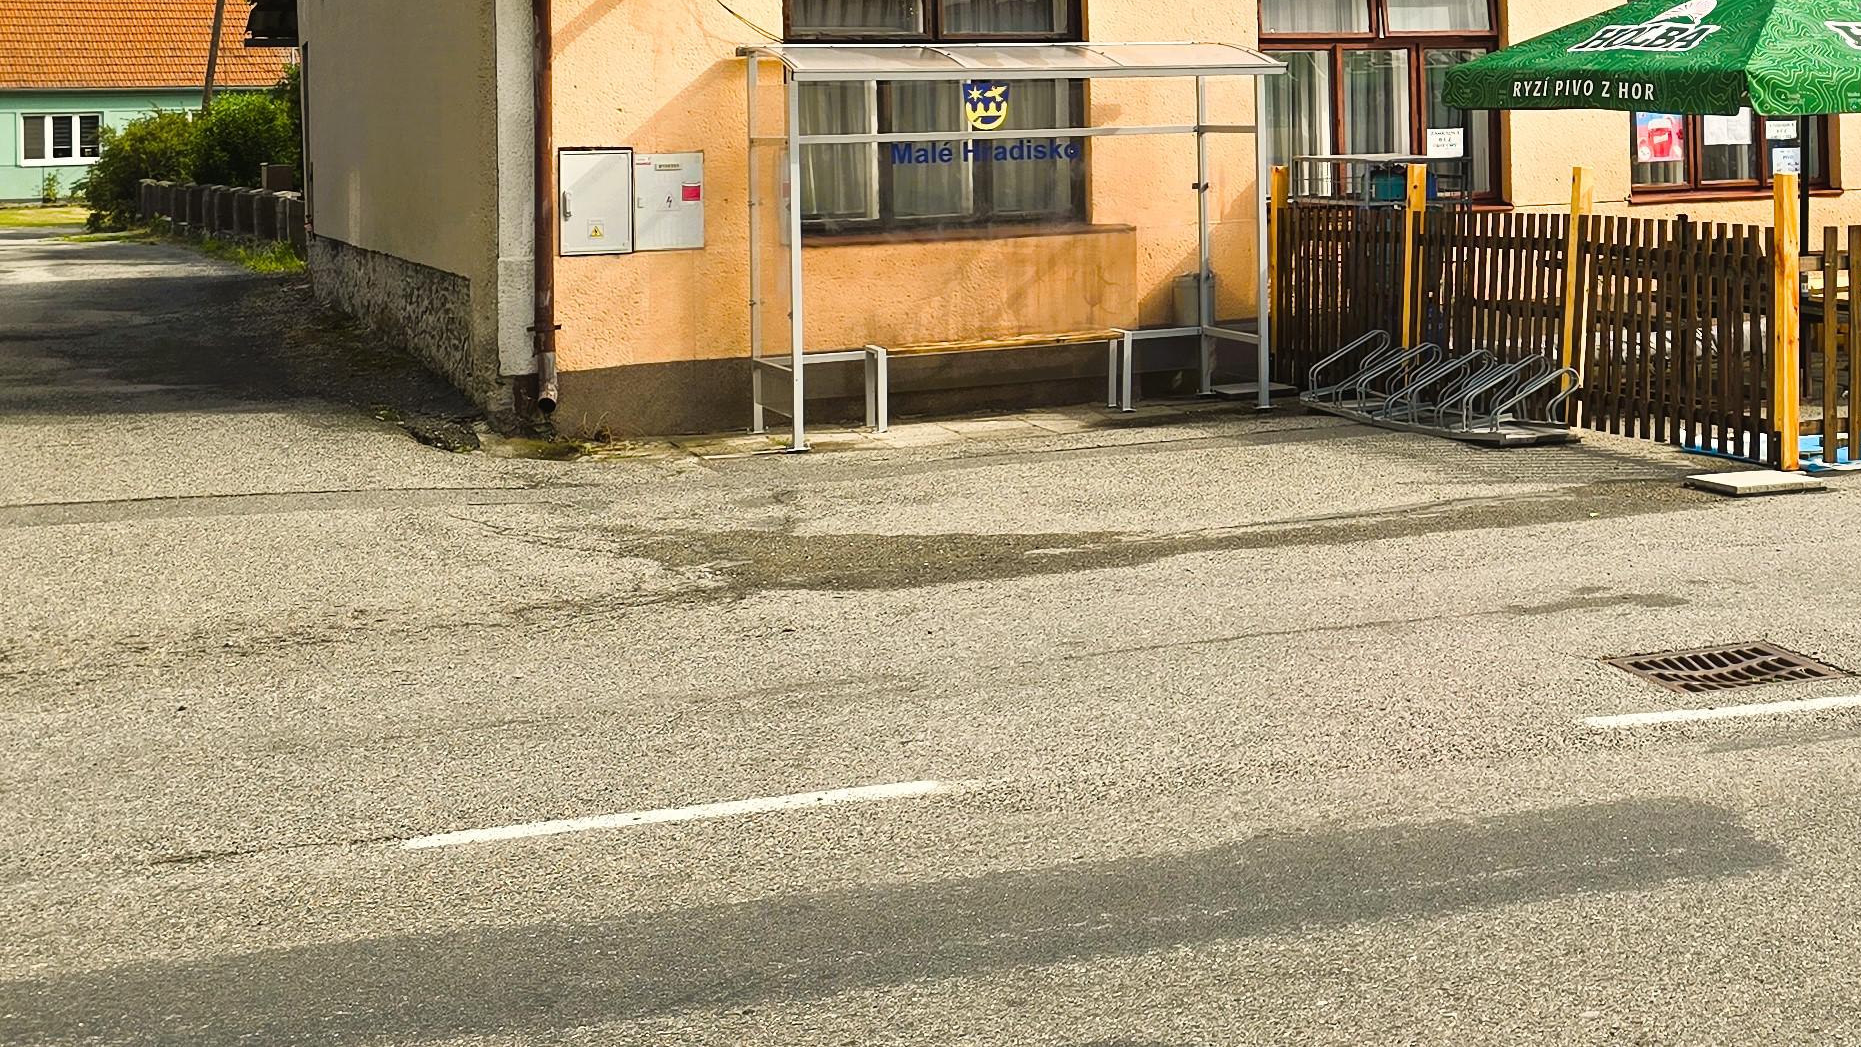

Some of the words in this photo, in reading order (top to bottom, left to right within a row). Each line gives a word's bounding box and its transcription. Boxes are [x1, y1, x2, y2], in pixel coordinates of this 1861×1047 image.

[1573, 25, 1711, 49] HOLBA
[1512, 76, 1550, 97] RYZÍ
[1554, 79, 1594, 96] PIVO
[1601, 81, 1610, 98] Z
[1618, 82, 1655, 101] HOR
[891, 141, 953, 165] Malé
[963, 139, 1081, 162] Hradisko
